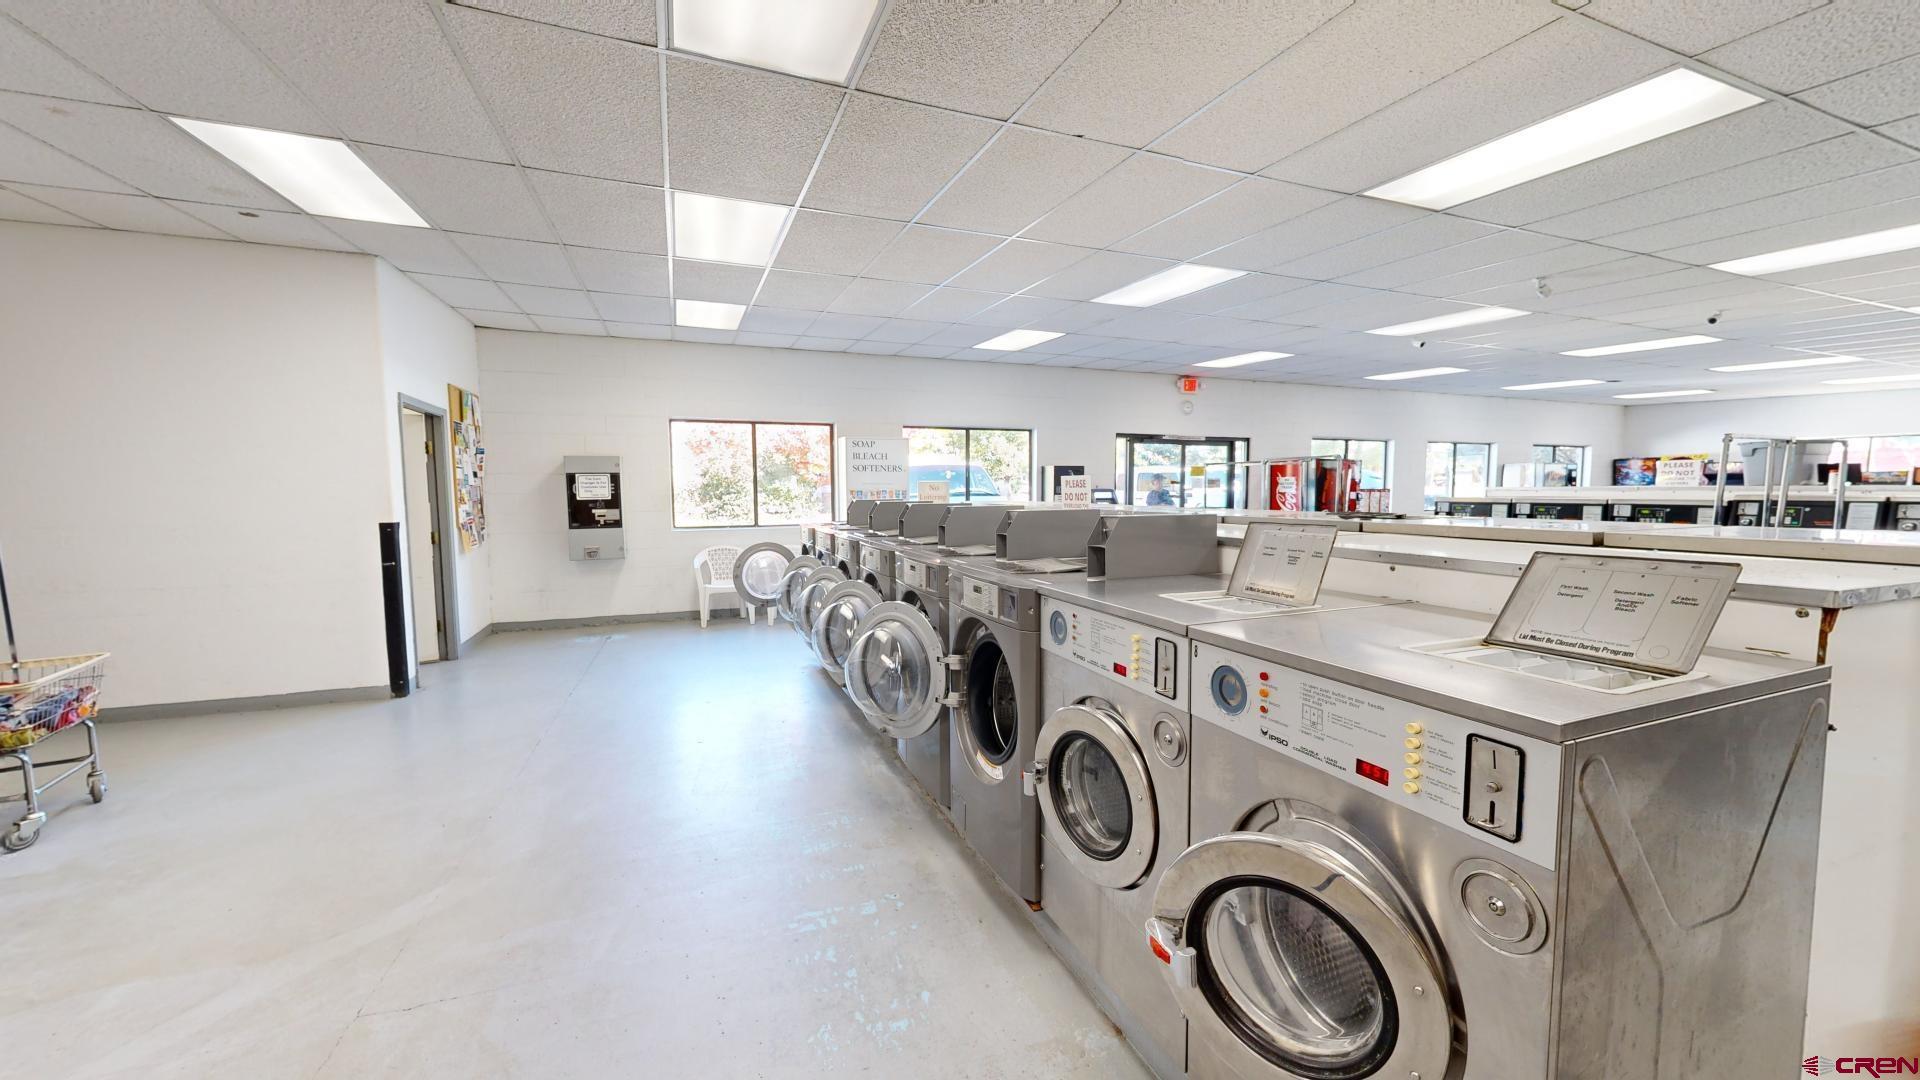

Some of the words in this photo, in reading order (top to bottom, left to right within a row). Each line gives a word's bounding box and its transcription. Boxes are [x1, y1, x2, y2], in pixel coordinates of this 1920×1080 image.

[1065, 480, 1087, 488] PLEASE
[1075, 493, 1088, 501] NOT
[1530, 634, 1545, 643] Must
[1555, 639, 1577, 648] Closed
[1578, 643, 1601, 653] During
[1601, 647, 1634, 658] Program
[1367, 701, 1384, 711] handle
[1269, 734, 1289, 747] IPSO
